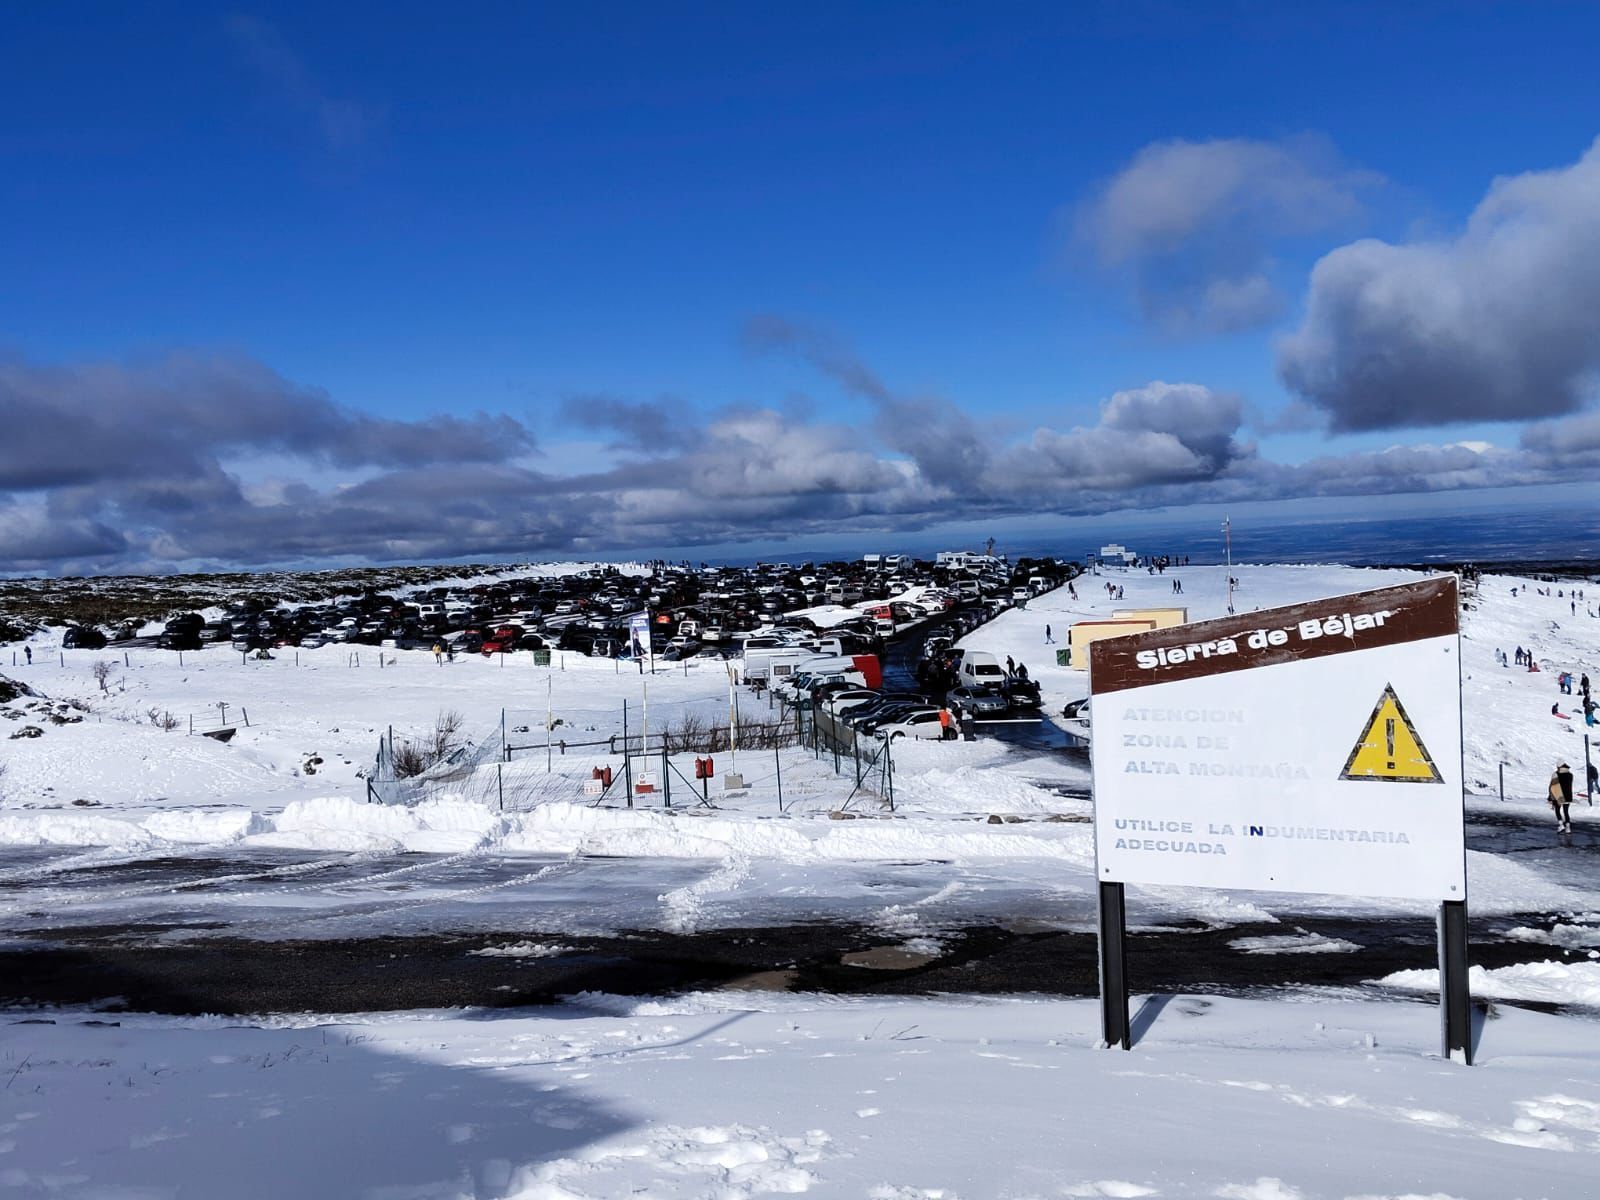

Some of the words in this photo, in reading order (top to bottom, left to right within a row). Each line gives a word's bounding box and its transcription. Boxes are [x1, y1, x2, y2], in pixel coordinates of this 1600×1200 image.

[1136, 638, 1237, 670] Sierra
[1248, 629, 1288, 649] de
[1299, 611, 1391, 640] Béjar
[1122, 708, 1244, 723] ATENCION
[1123, 734, 1187, 749] ZONA
[1197, 736, 1229, 750] DE
[1124, 761, 1181, 776] ALTA
[1190, 761, 1311, 780] MONTAÑA
[1115, 819, 1193, 834] UTILICE
[1208, 824, 1235, 836] LA
[1243, 825, 1411, 845] INDUMENTARIA
[1114, 838, 1227, 856] ADECUADA
